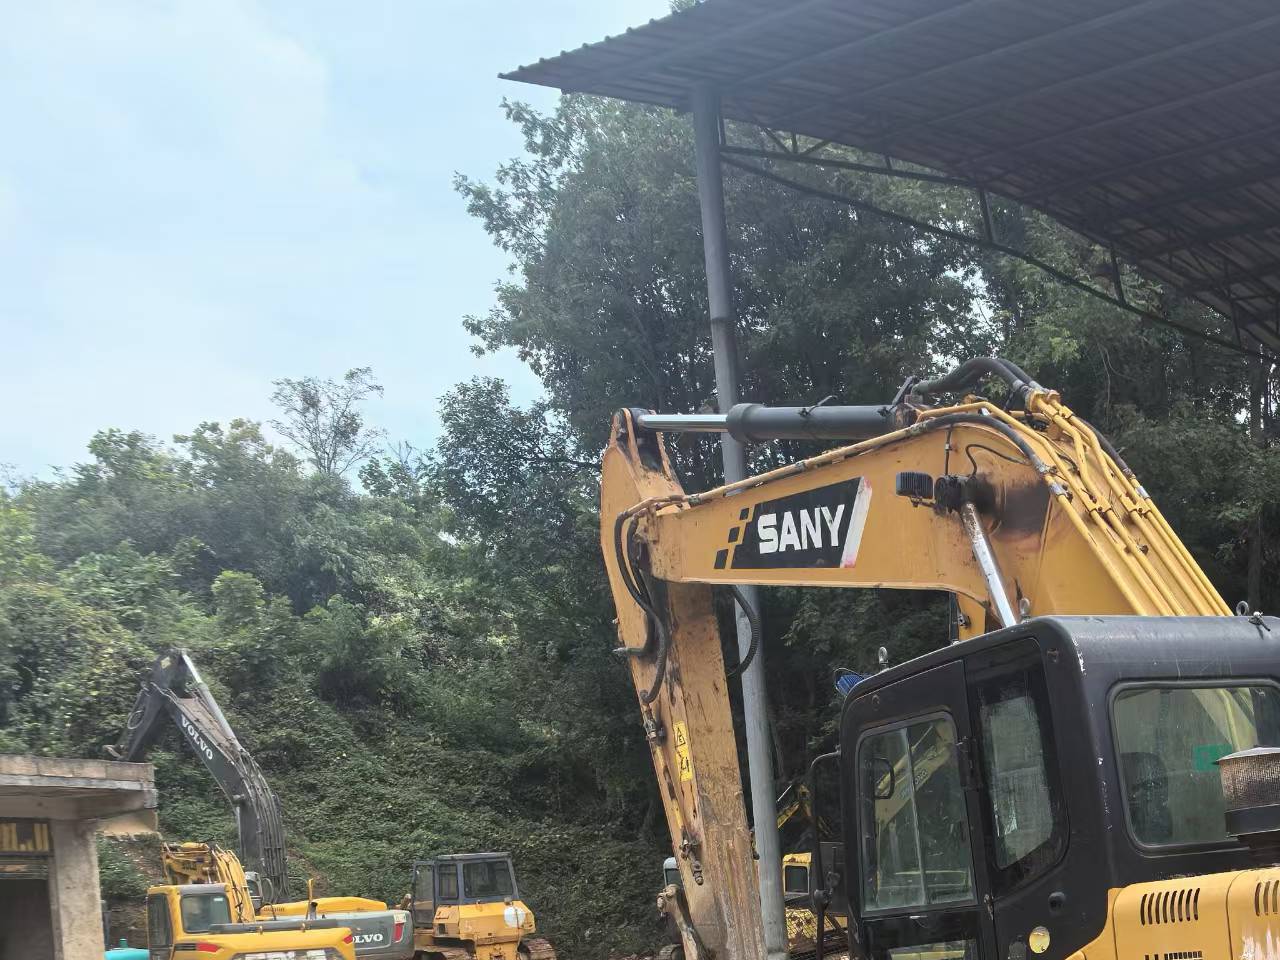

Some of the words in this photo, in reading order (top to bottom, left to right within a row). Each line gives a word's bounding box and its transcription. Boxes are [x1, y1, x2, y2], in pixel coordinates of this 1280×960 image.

[757, 503, 845, 554] SANY
[181, 713, 213, 760] VOLVO
[353, 933, 384, 944] LVO
